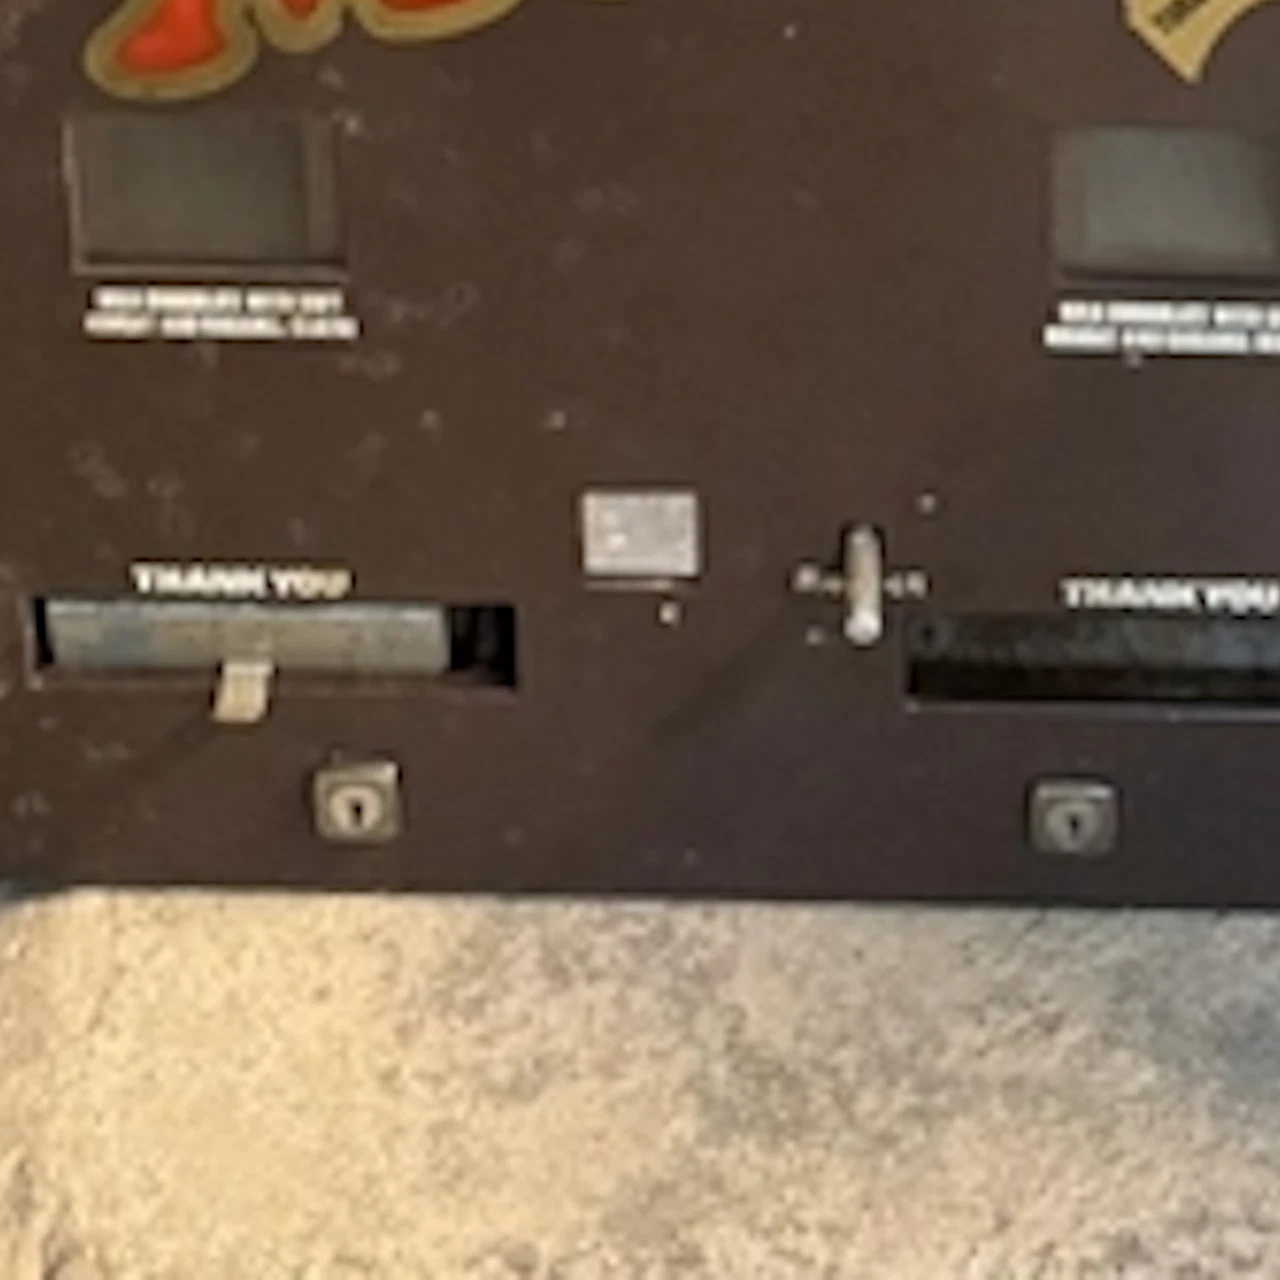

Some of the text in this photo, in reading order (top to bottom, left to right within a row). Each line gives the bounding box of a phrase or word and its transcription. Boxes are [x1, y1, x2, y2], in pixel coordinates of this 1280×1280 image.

[129, 561, 352, 600] THANK YOU
[1059, 577, 1199, 612] THANK
